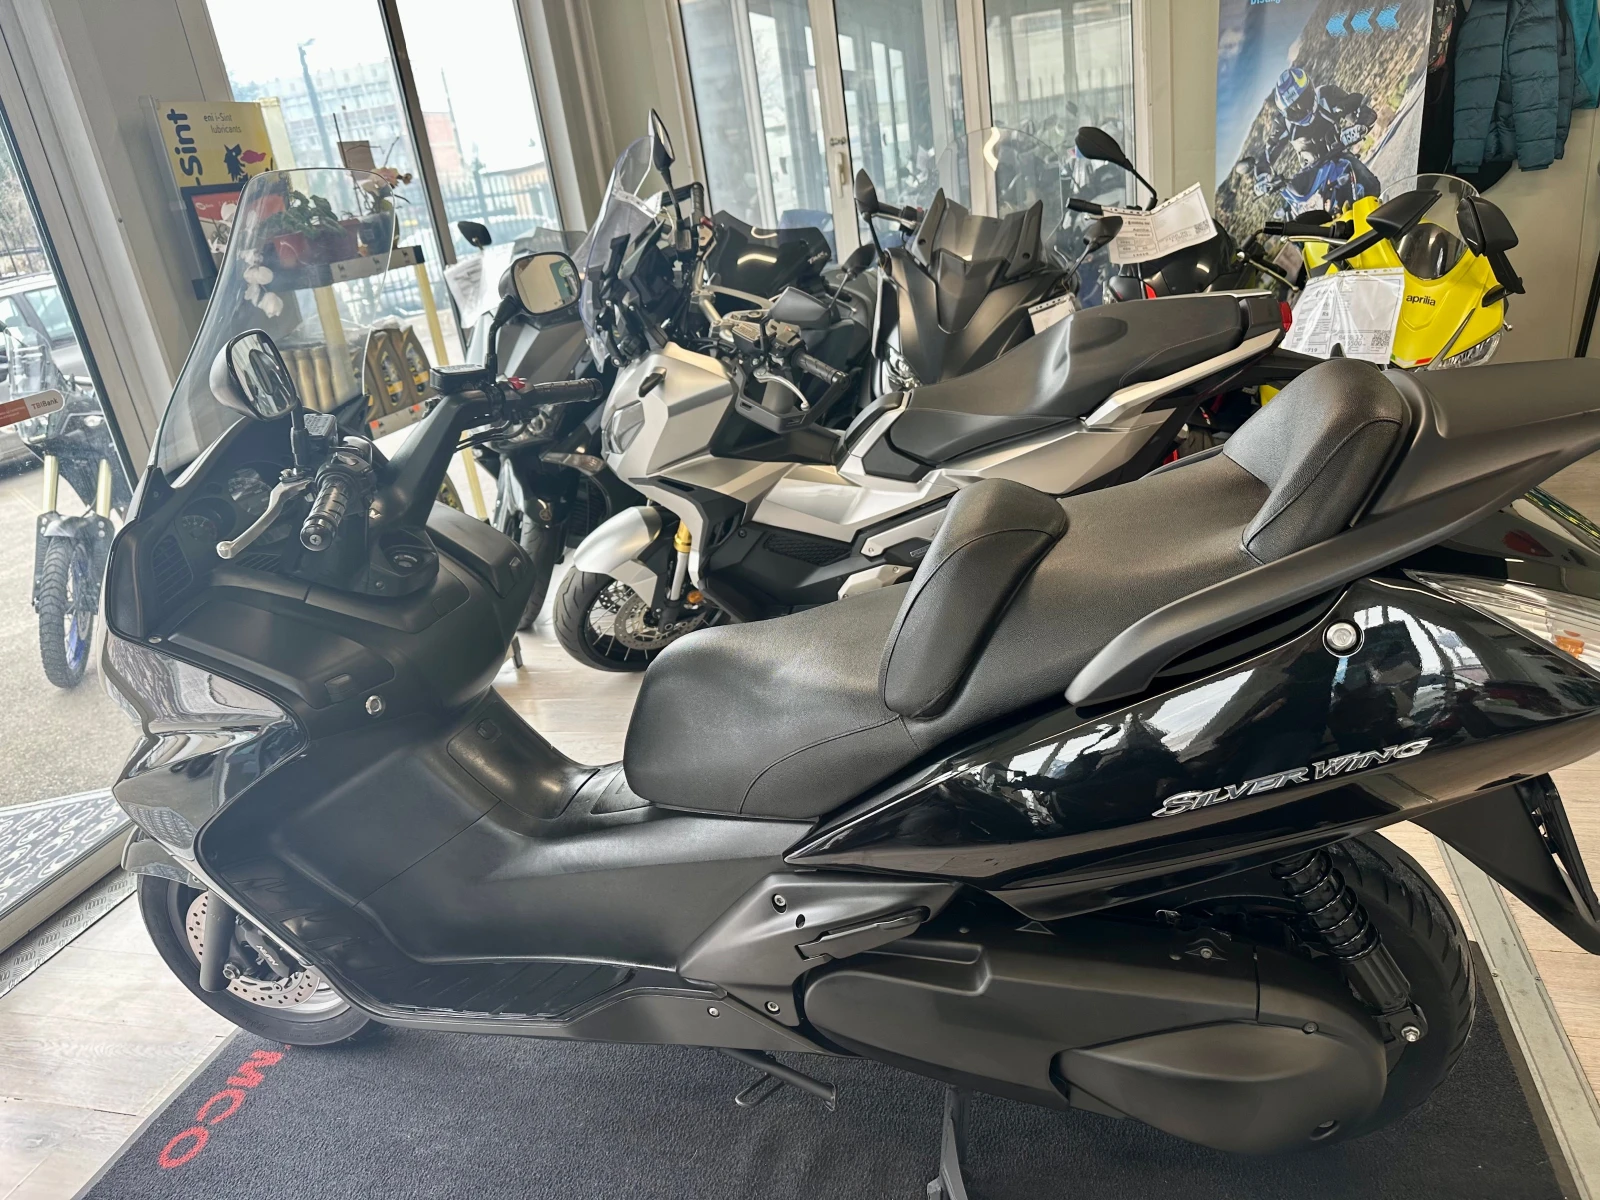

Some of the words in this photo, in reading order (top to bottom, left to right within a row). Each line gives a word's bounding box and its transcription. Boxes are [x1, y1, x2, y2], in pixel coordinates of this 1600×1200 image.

[203, 113, 214, 122] eni
[214, 112, 233, 122] i-Sint
[210, 125, 242, 134] lubricants
[1405, 294, 1436, 307] aprilia
[1151, 766, 1310, 818] SILVER
[1313, 737, 1433, 780] WING
